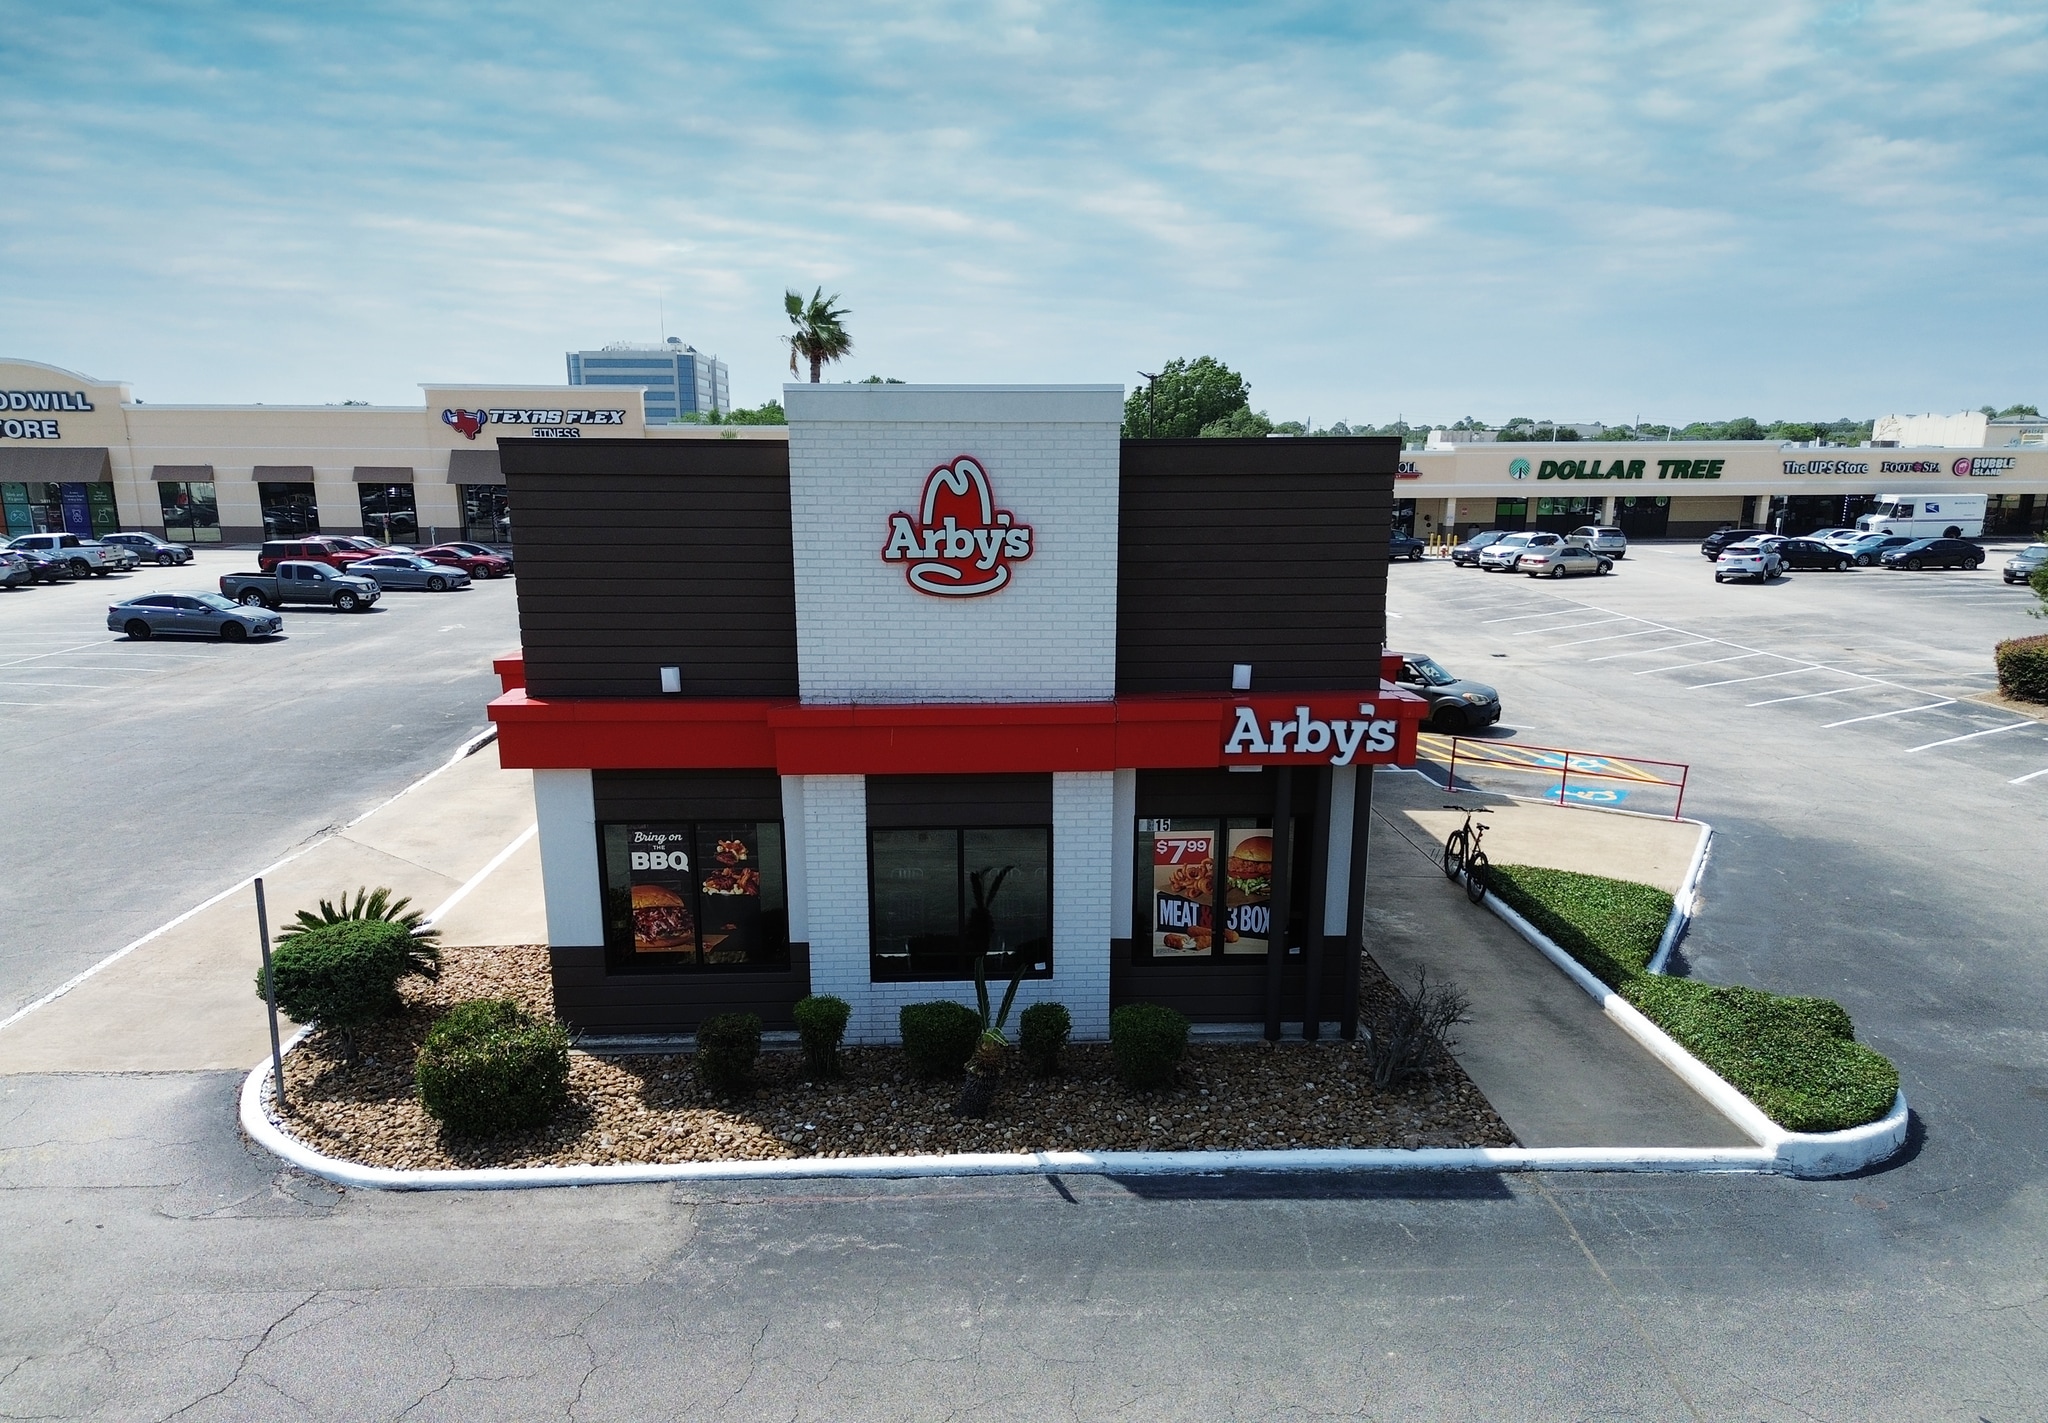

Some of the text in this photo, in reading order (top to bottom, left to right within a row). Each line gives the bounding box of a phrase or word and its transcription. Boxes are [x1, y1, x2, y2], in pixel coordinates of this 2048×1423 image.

[488, 410, 626, 424] TEXAS FLEX
[532, 428, 580, 438] FITNESS
[1537, 459, 1725, 480] DOLLAR TREE
[1784, 461, 1869, 474] The UPS Store
[1881, 462, 1941, 473] FOOT SPA
[1972, 457, 2016, 469] BUBBLE
[1971, 468, 2001, 476] ISLAND
[885, 513, 1030, 570] Arby's
[1224, 703, 1397, 766] Arby's
[634, 831, 667, 844] Bring
[631, 851, 689, 872] BBQ
[1159, 899, 1200, 927] MEAT
[1226, 906, 1238, 930] 3
[1240, 905, 1270, 934] BOX
